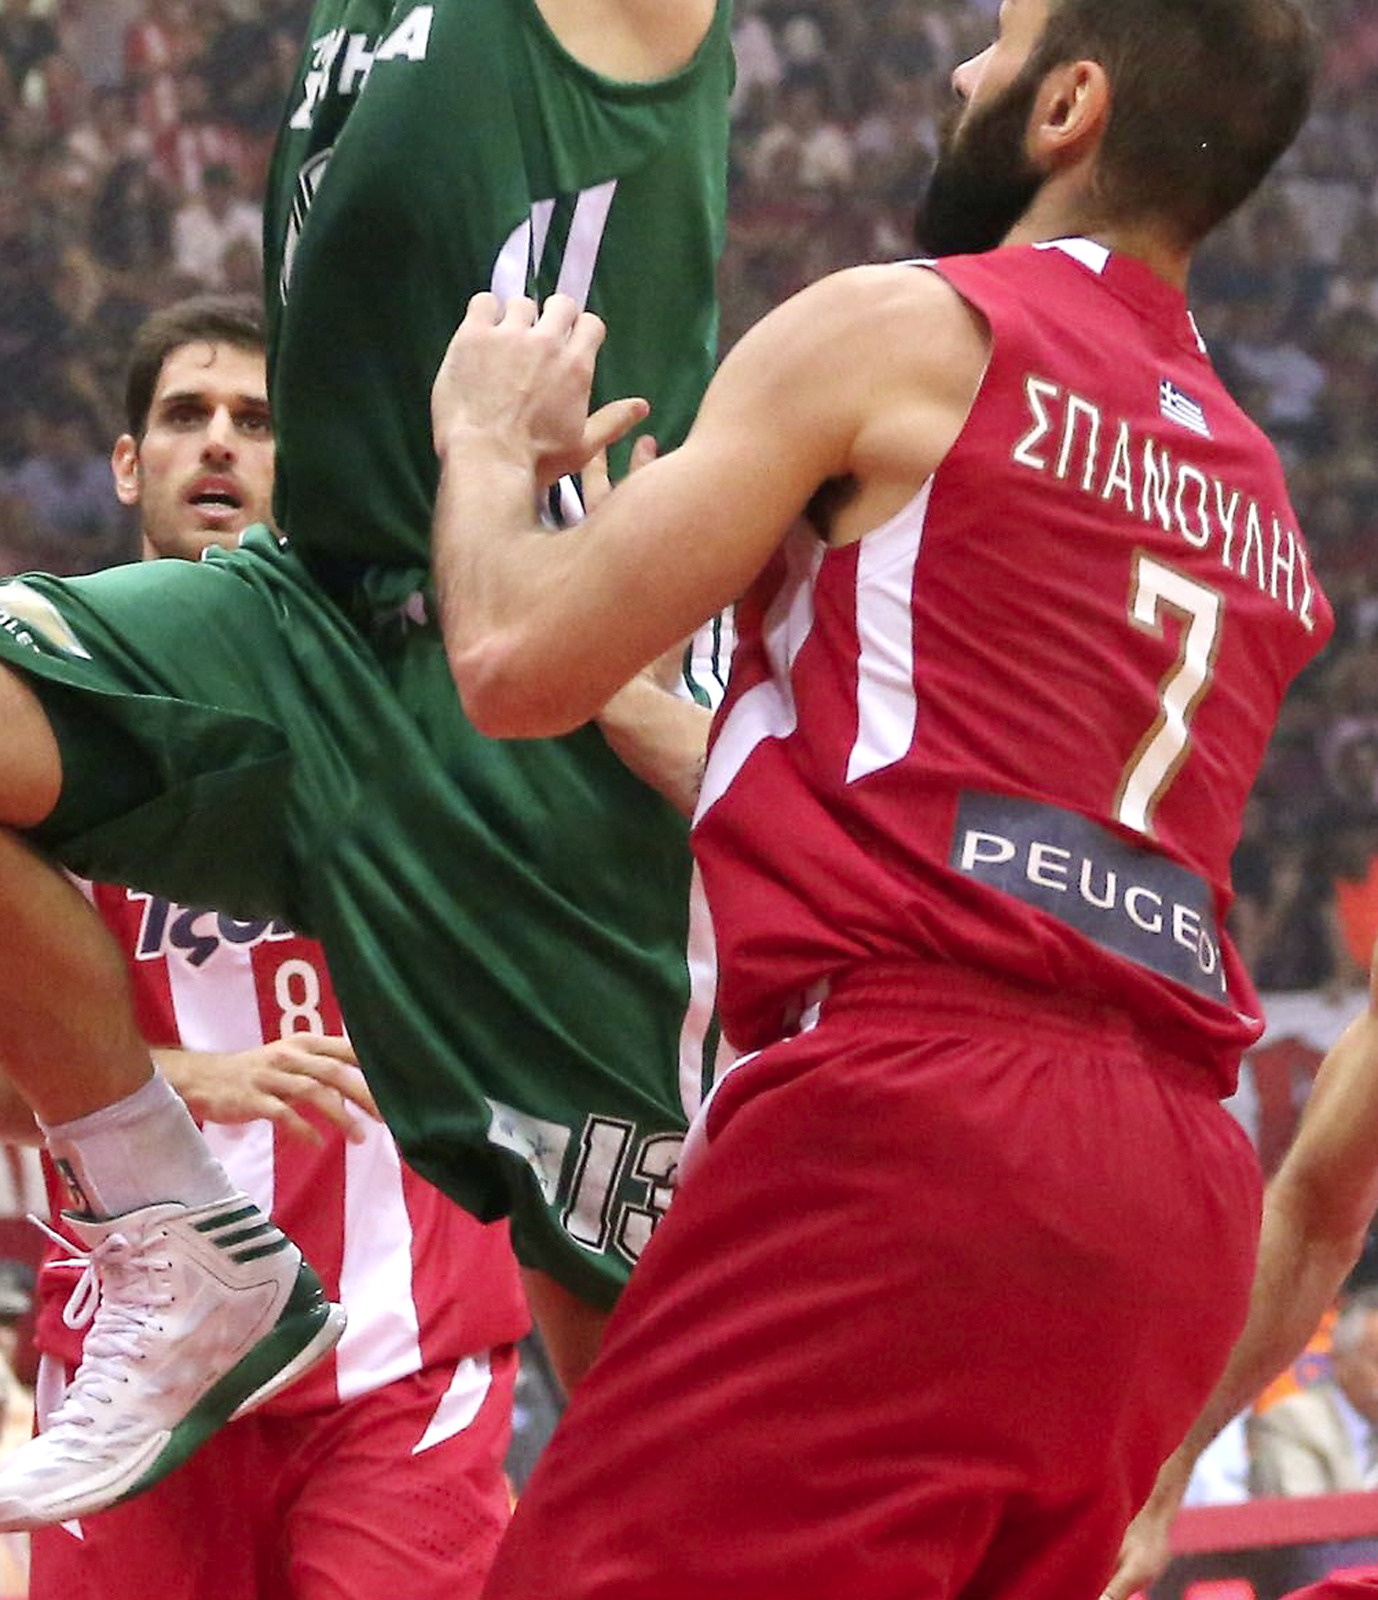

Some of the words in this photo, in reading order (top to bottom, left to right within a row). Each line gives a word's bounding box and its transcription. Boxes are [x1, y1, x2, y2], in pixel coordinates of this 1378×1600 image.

[1011, 376, 1315, 634] ΣΠΑΝΟΥΛΗΣ
[1113, 546, 1226, 840] 7
[960, 829, 1227, 994] PEUGEO
[275, 959, 325, 1040] 8
[560, 1113, 688, 1266] 13
